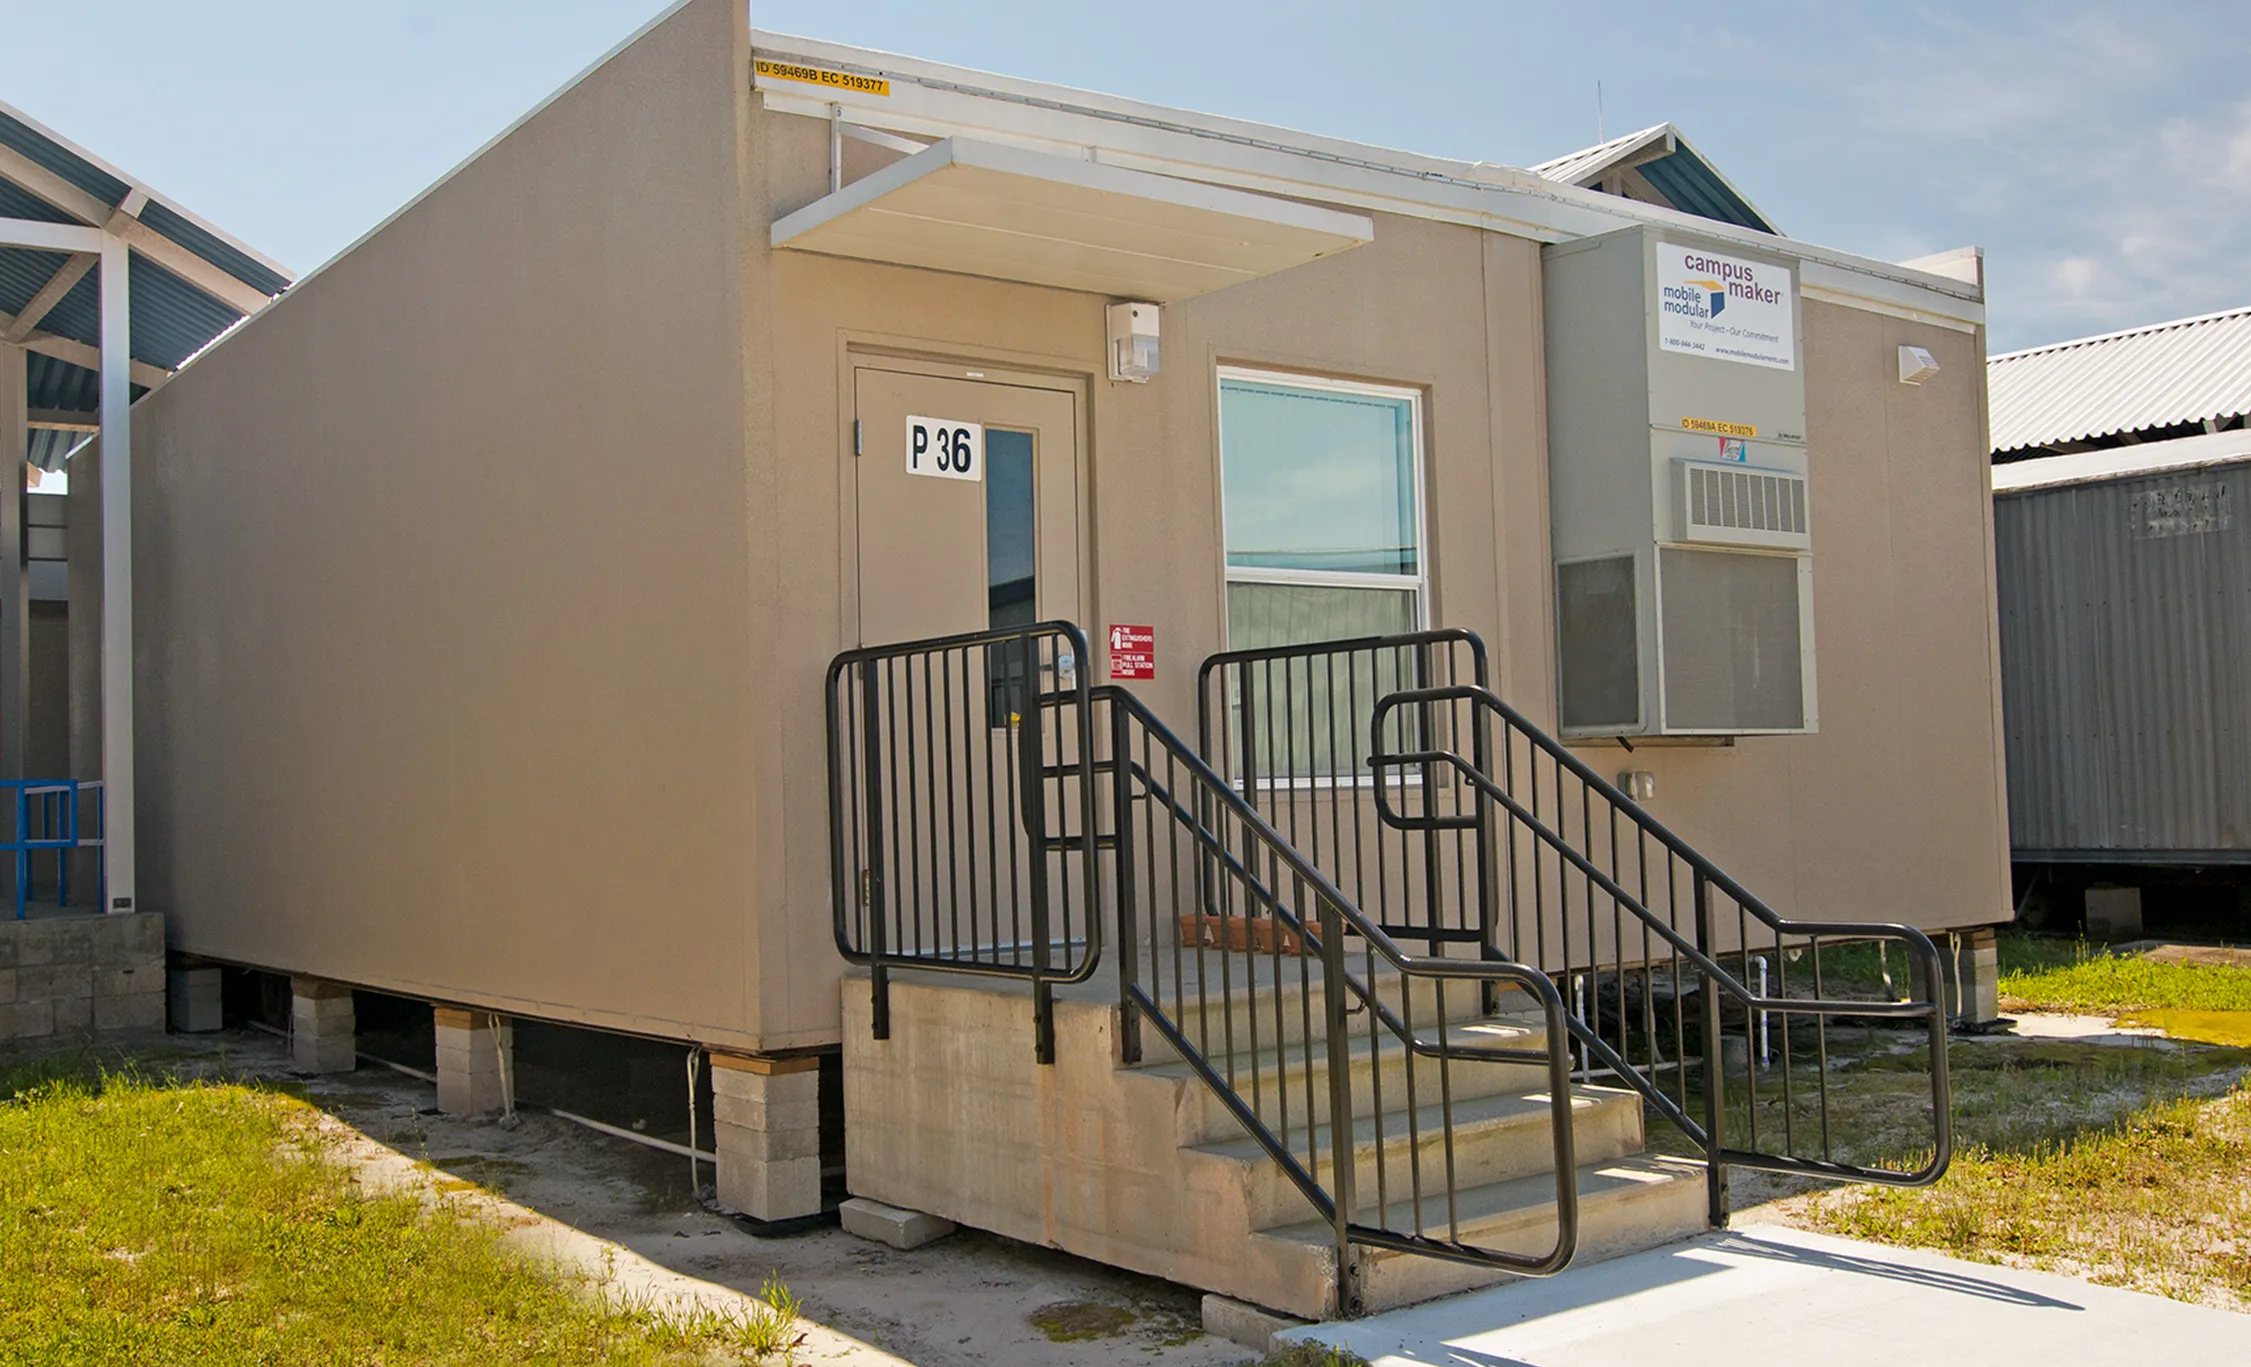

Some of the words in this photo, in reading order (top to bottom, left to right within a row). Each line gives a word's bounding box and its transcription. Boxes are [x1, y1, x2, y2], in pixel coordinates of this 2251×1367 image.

[755, 60, 769, 73] ID
[773, 63, 818, 80] 59469B
[821, 71, 839, 84] EC
[842, 76, 883, 92] 519377
[1684, 255, 1754, 282] campus
[1663, 286, 1701, 303] mobile
[1728, 281, 1781, 305] maker
[1663, 301, 1709, 318] modular
[1690, 320, 1703, 329] Your
[1742, 329, 1779, 343] Commitment
[1682, 418, 1690, 429] ID
[1718, 424, 1729, 433] EC
[912, 424, 928, 469] P
[936, 427, 972, 473] 36
